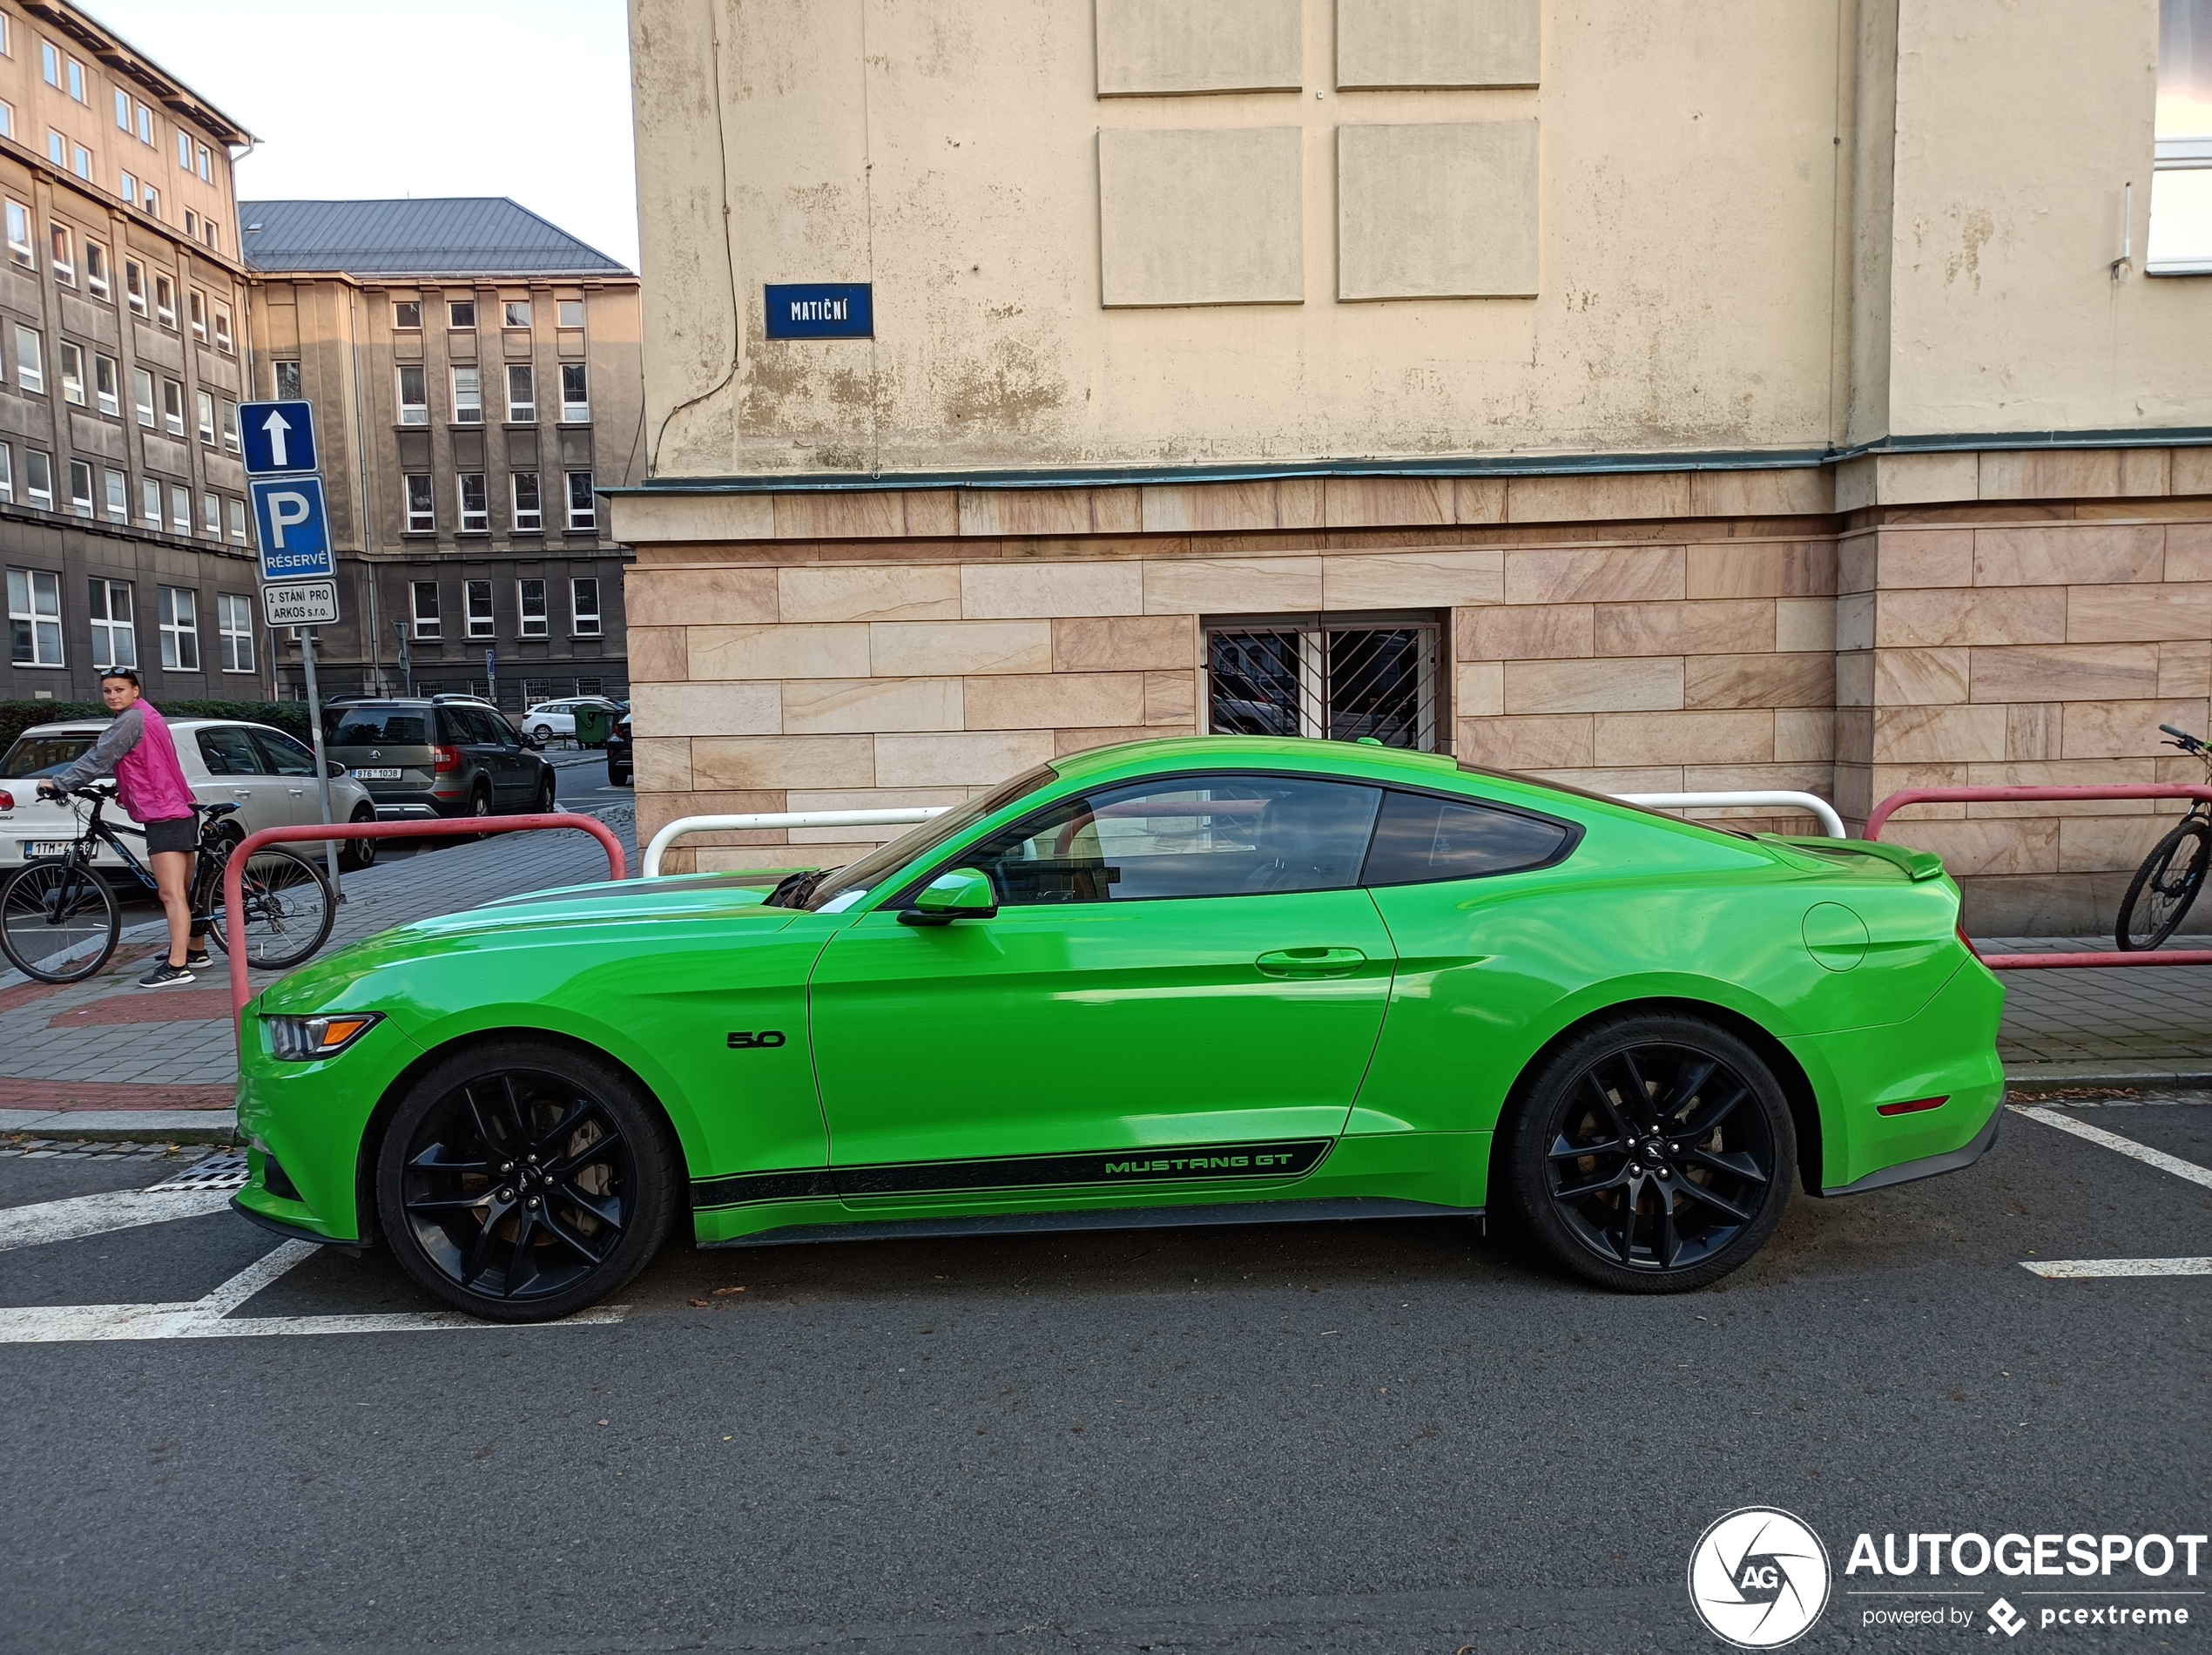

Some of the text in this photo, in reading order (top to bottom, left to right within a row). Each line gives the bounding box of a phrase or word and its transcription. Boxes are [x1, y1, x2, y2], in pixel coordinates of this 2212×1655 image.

[791, 298, 848, 321] MATIČNÍ
[266, 491, 310, 549] P
[266, 551, 327, 569] RÉSERVÉ
[268, 588, 329, 604] 2 STÁNÍ PRO
[273, 606, 328, 618] ARKOS s.r.o.
[357, 769, 373, 778] 9T6
[36, 842, 56, 855] 1TM
[726, 1030, 786, 1050] 5.0
[1105, 1153, 1293, 1173] MUSTANG GT
